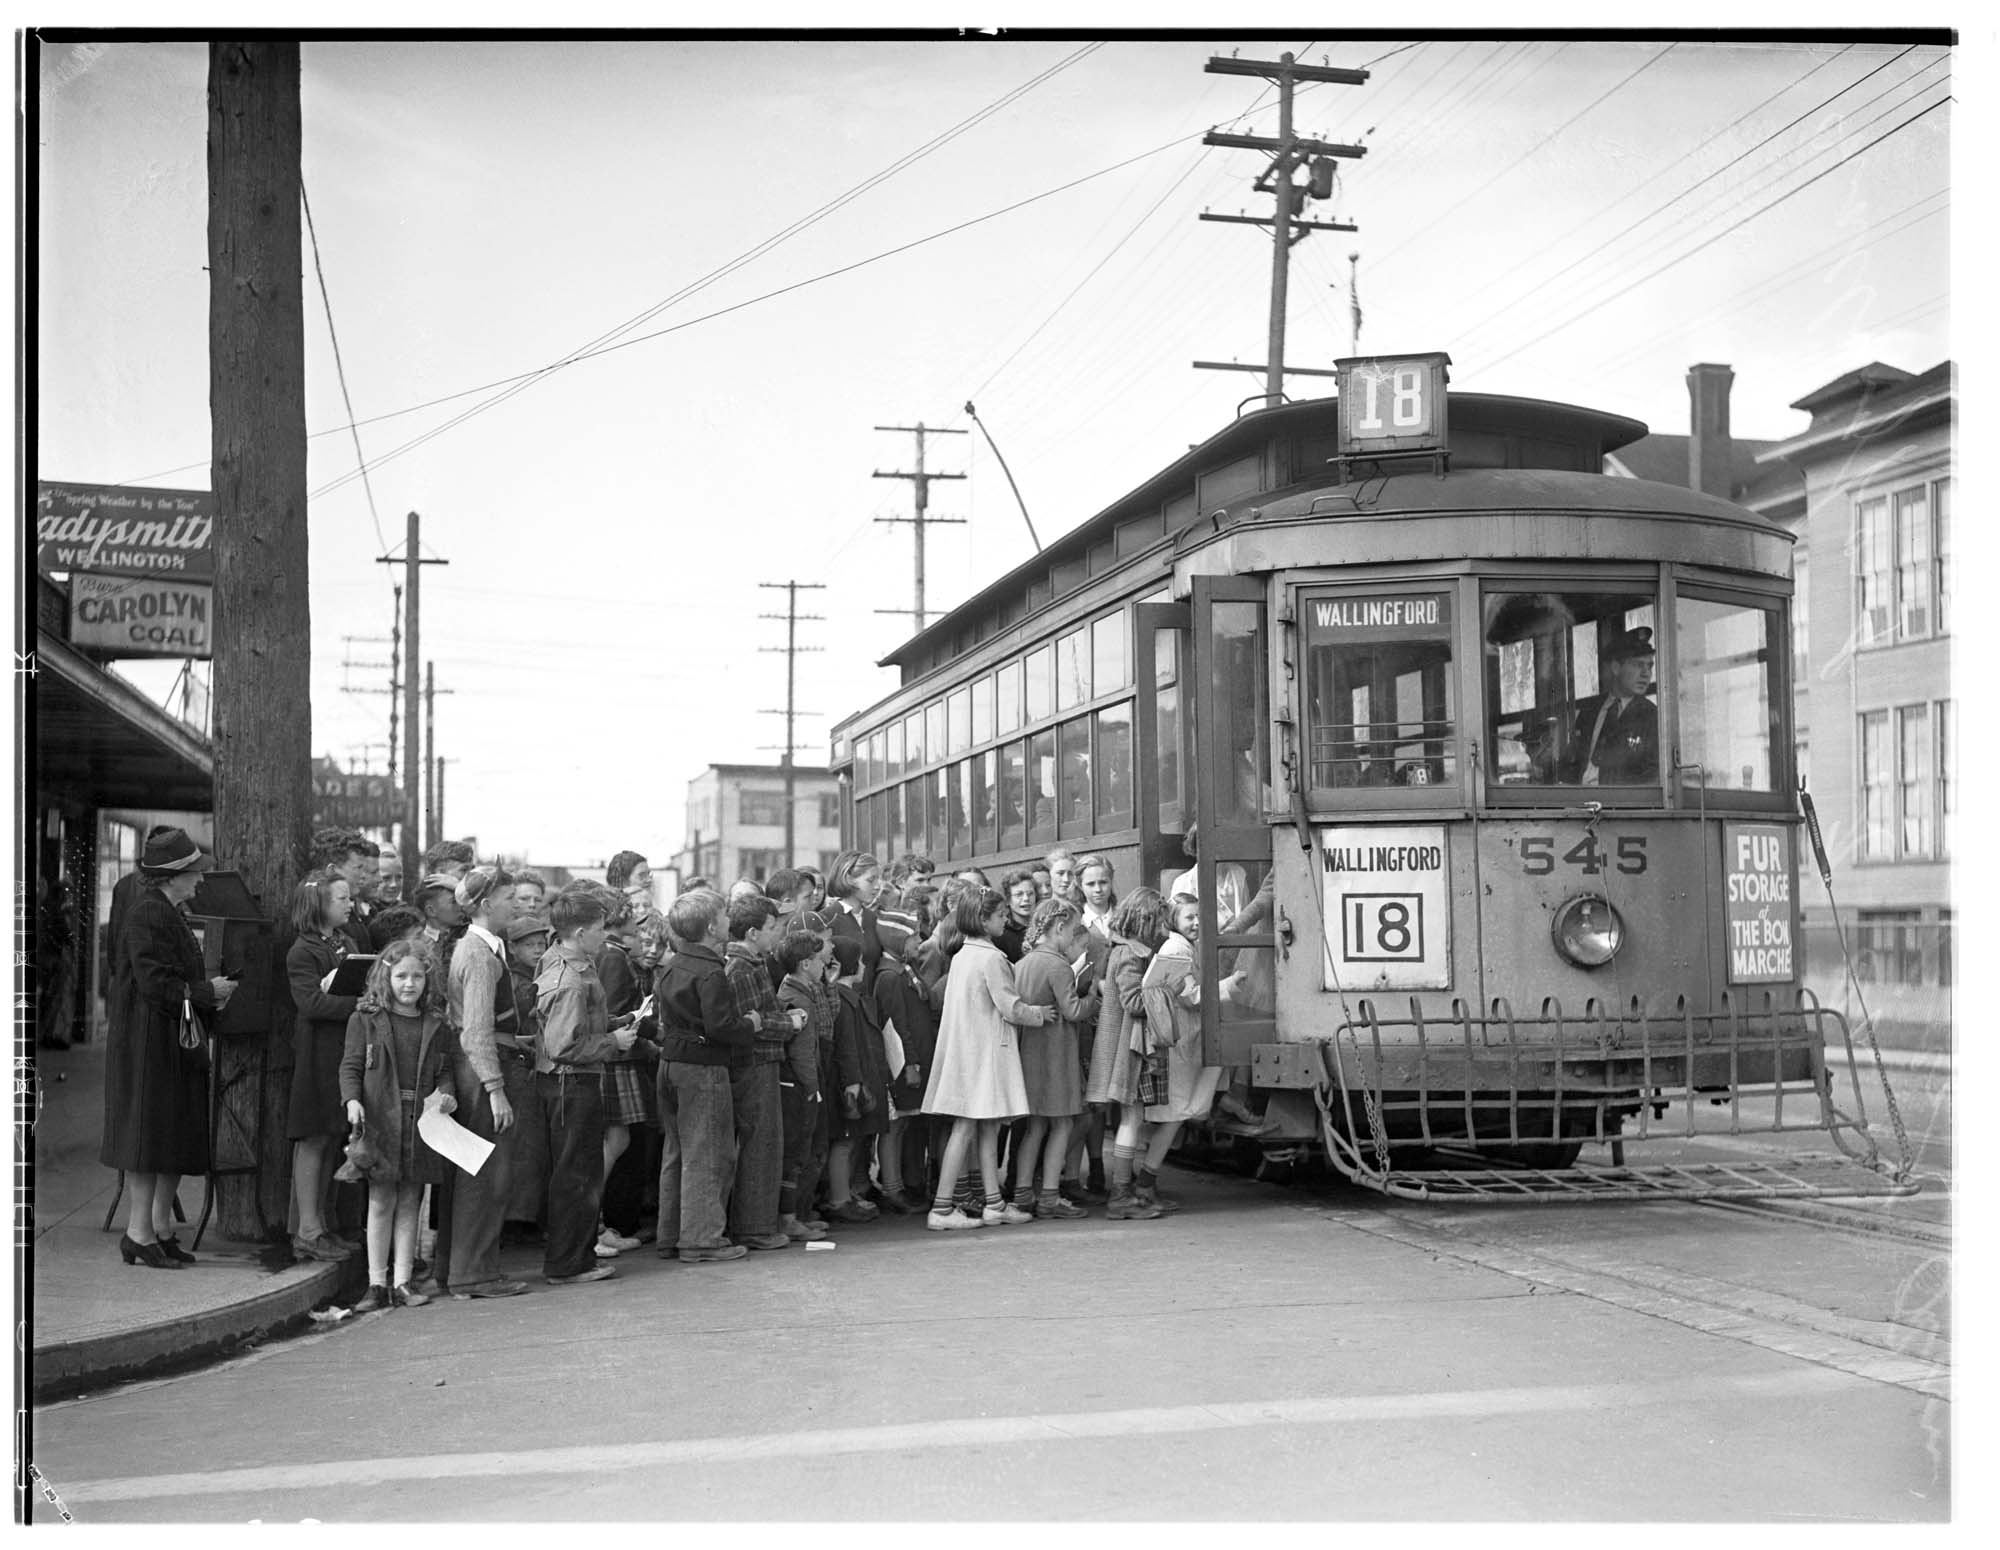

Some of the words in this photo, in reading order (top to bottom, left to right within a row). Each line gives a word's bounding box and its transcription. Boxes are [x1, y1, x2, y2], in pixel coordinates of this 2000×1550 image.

[1359, 365, 1422, 430] 18
[37, 507, 212, 566] adysmit
[57, 547, 186, 570] WELLINGTON
[78, 592, 206, 624] CAROLYN
[1316, 600, 1438, 627] WALLINGFORD
[129, 623, 205, 647] COAL
[1322, 846, 1441, 873] WALLINGFORD
[1520, 836, 1647, 876] 545
[1737, 835, 1782, 872] FUR
[1728, 873, 1789, 903] STORAGE
[1758, 904, 1771, 920] at
[1354, 902, 1411, 953] 18
[1732, 920, 1761, 947] THE
[1763, 919, 1790, 946] BON
